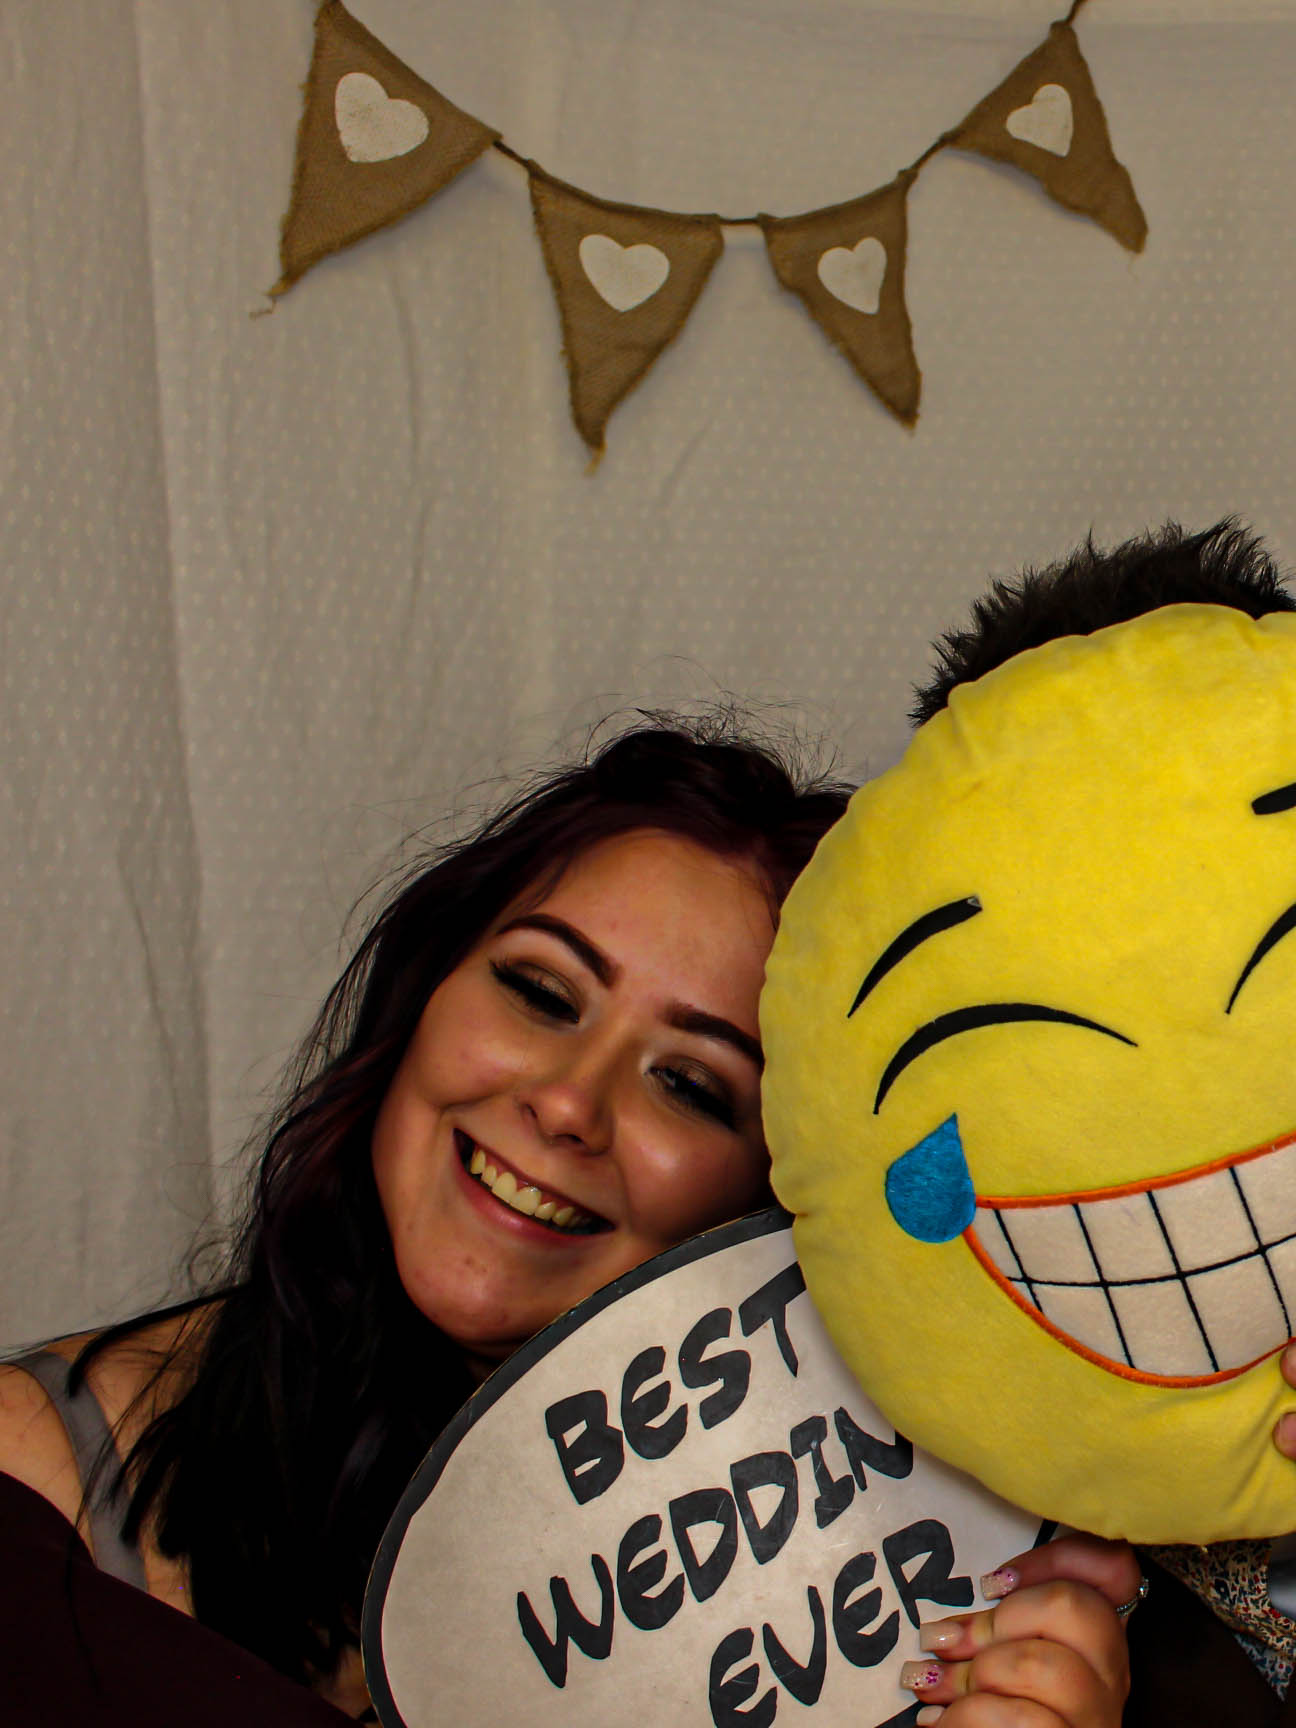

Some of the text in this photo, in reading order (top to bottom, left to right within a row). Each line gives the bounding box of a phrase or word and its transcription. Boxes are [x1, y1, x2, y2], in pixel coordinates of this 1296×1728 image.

[545, 1262, 806, 1505] BEST
[517, 1406, 914, 1689] WEDDIN
[708, 1519, 975, 1728] EVER
